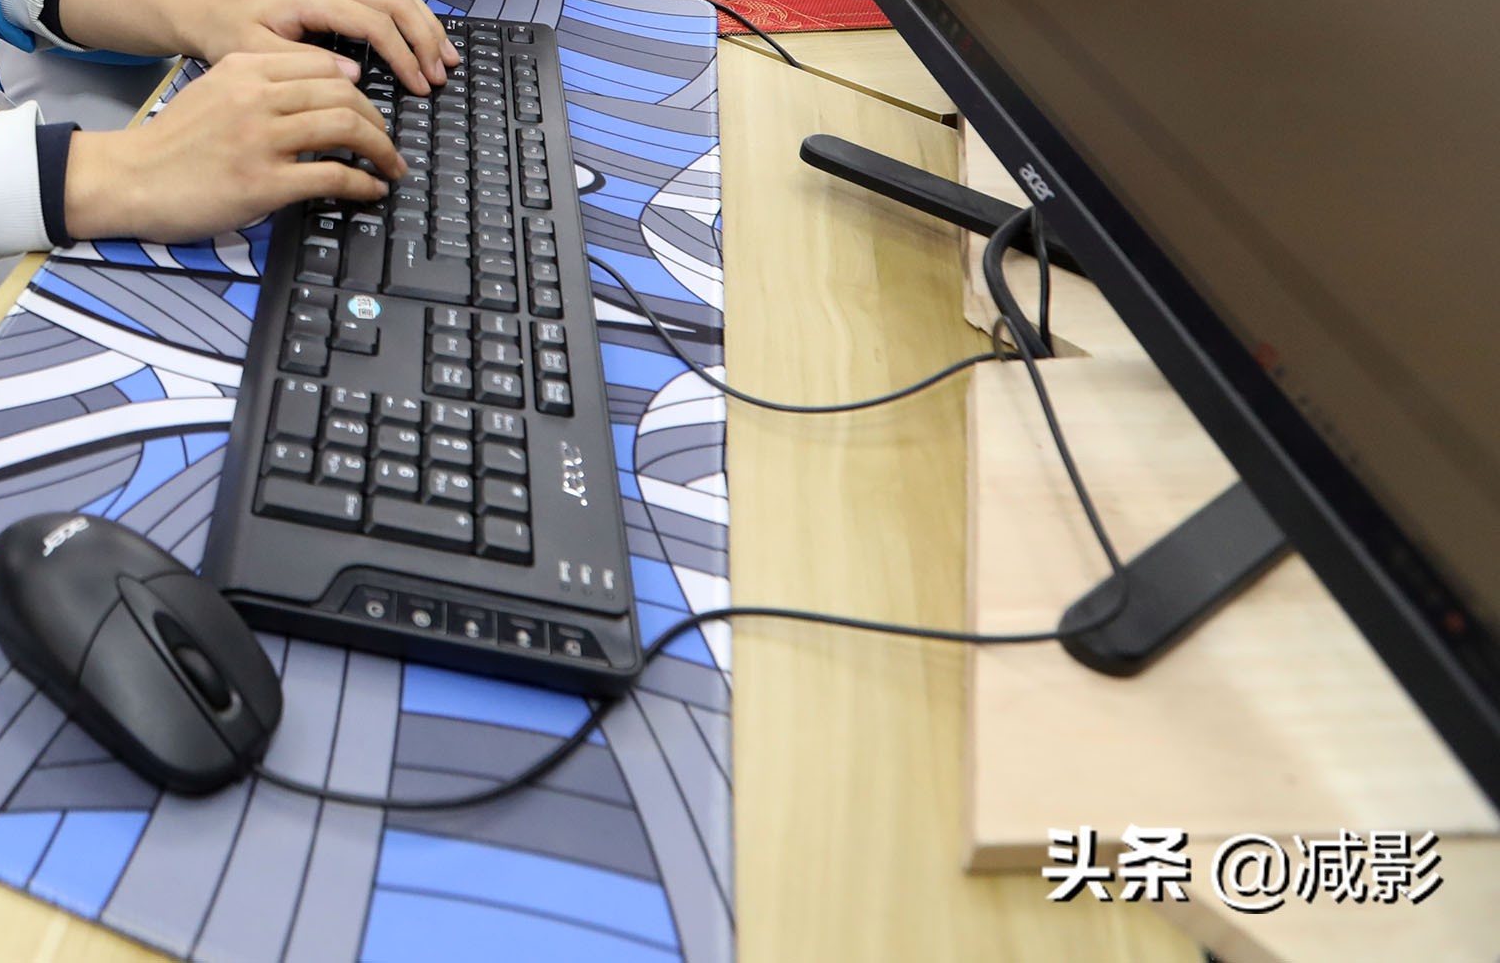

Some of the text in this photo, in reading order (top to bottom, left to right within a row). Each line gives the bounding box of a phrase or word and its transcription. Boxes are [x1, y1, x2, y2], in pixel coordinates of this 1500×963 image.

[1019, 162, 1056, 202] acer
[399, 431, 416, 443] 5
[397, 466, 415, 478] 6
[42, 516, 90, 557] acer
